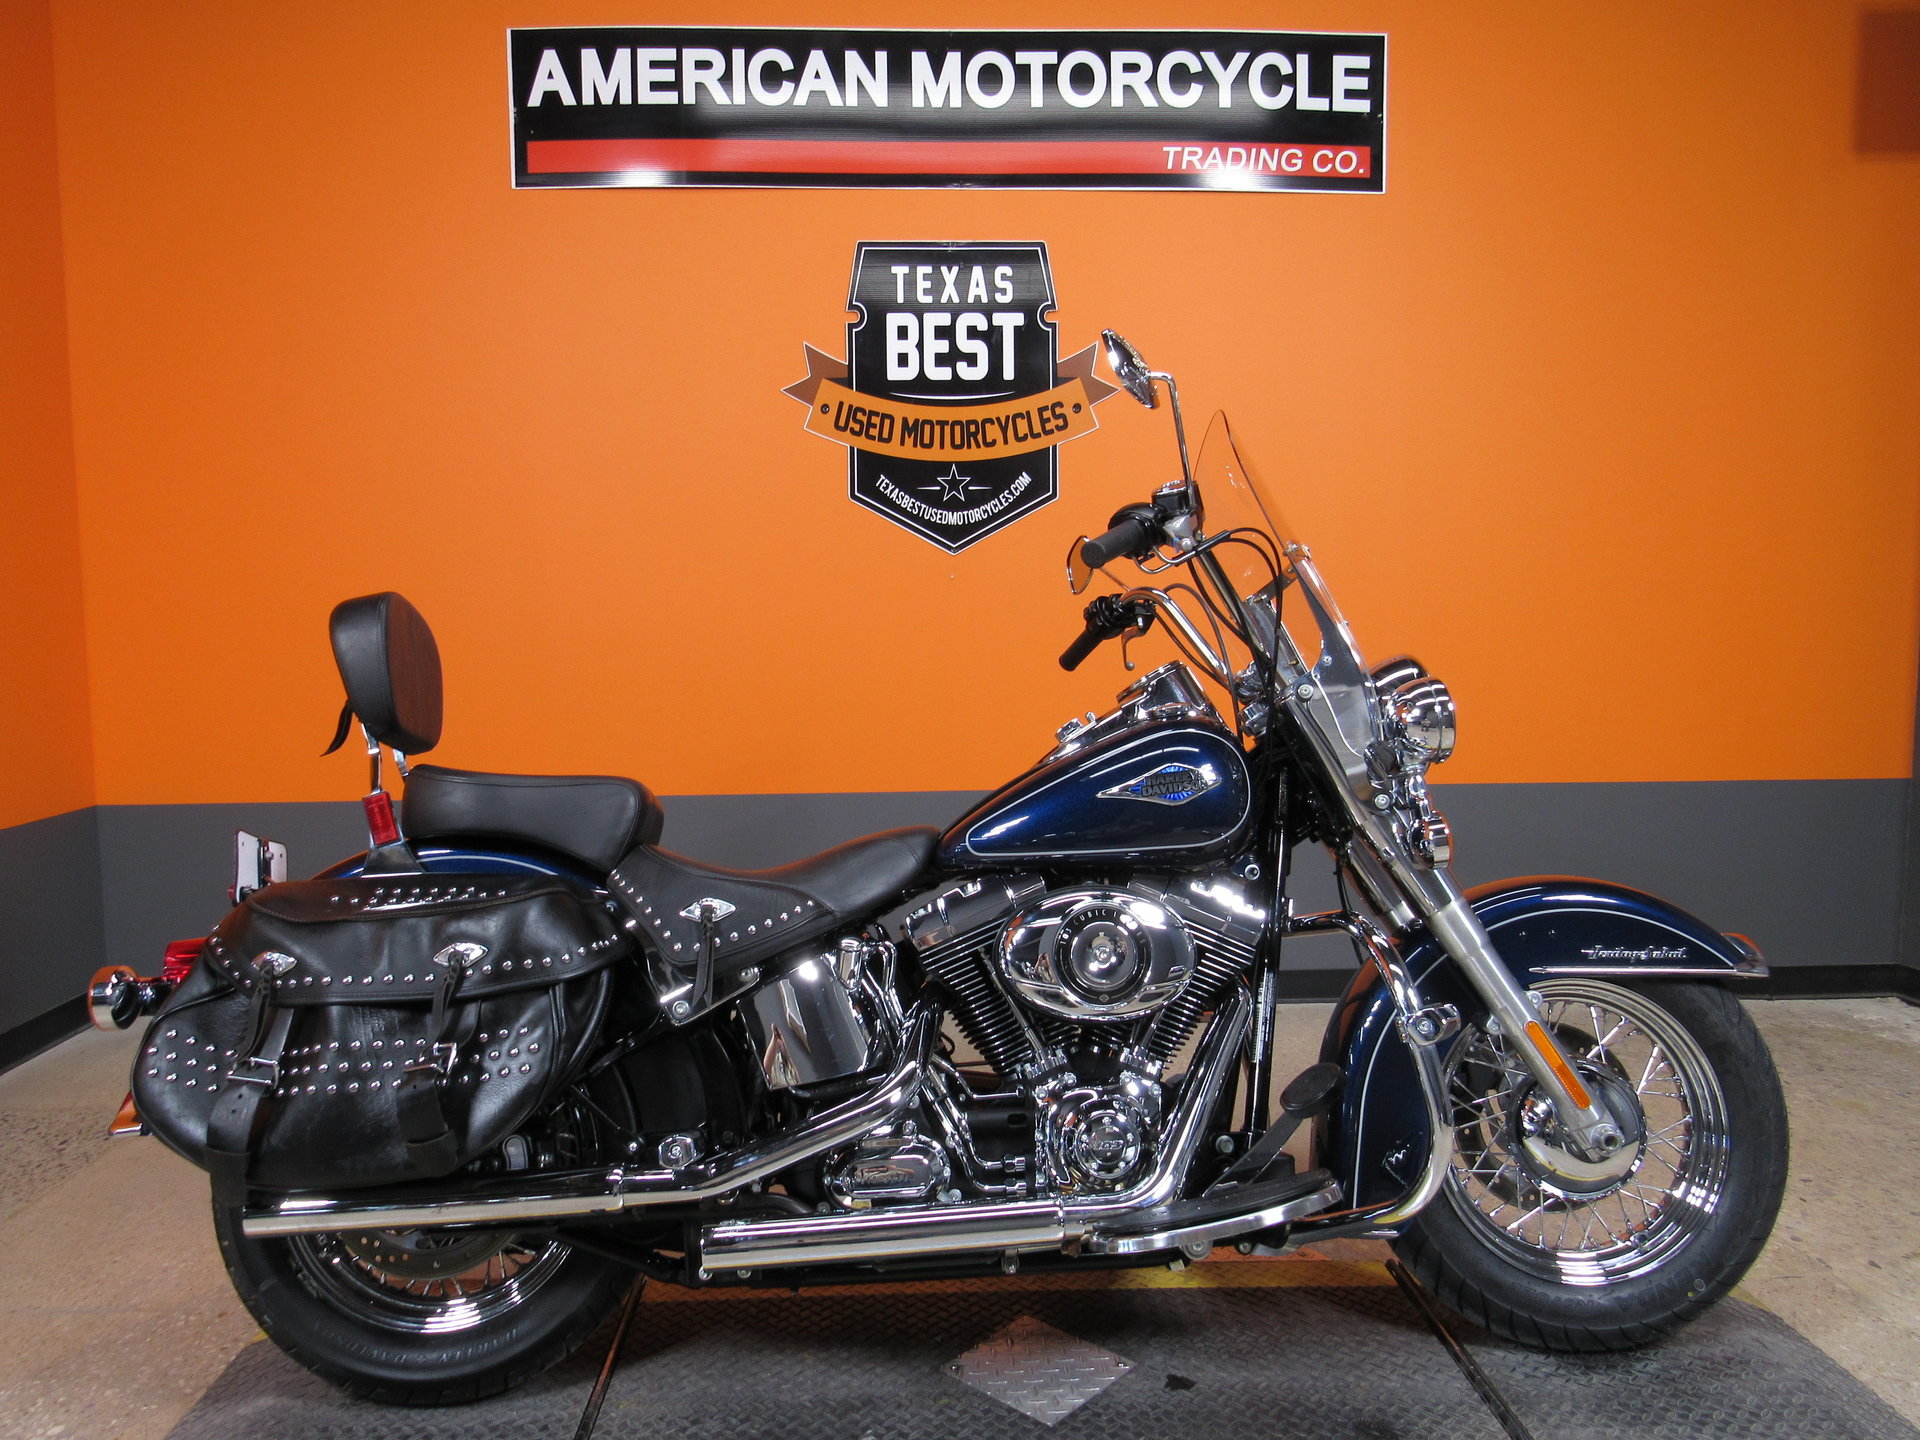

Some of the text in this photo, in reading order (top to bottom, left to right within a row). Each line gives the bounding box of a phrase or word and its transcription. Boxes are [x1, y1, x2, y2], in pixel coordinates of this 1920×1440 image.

[527, 48, 1371, 113] AMERICAN MOTORCYCLE
[1162, 147, 1365, 174] TRADING CO.
[891, 265, 1013, 304] TEXAS
[886, 312, 1025, 381] BEST
[833, 400, 1069, 450] USED MOTORCYCLES
[875, 471, 1032, 526] TEXASBESTUSEDMOTORCYCLES.COM
[1073, 909, 1106, 926] CUBIC
